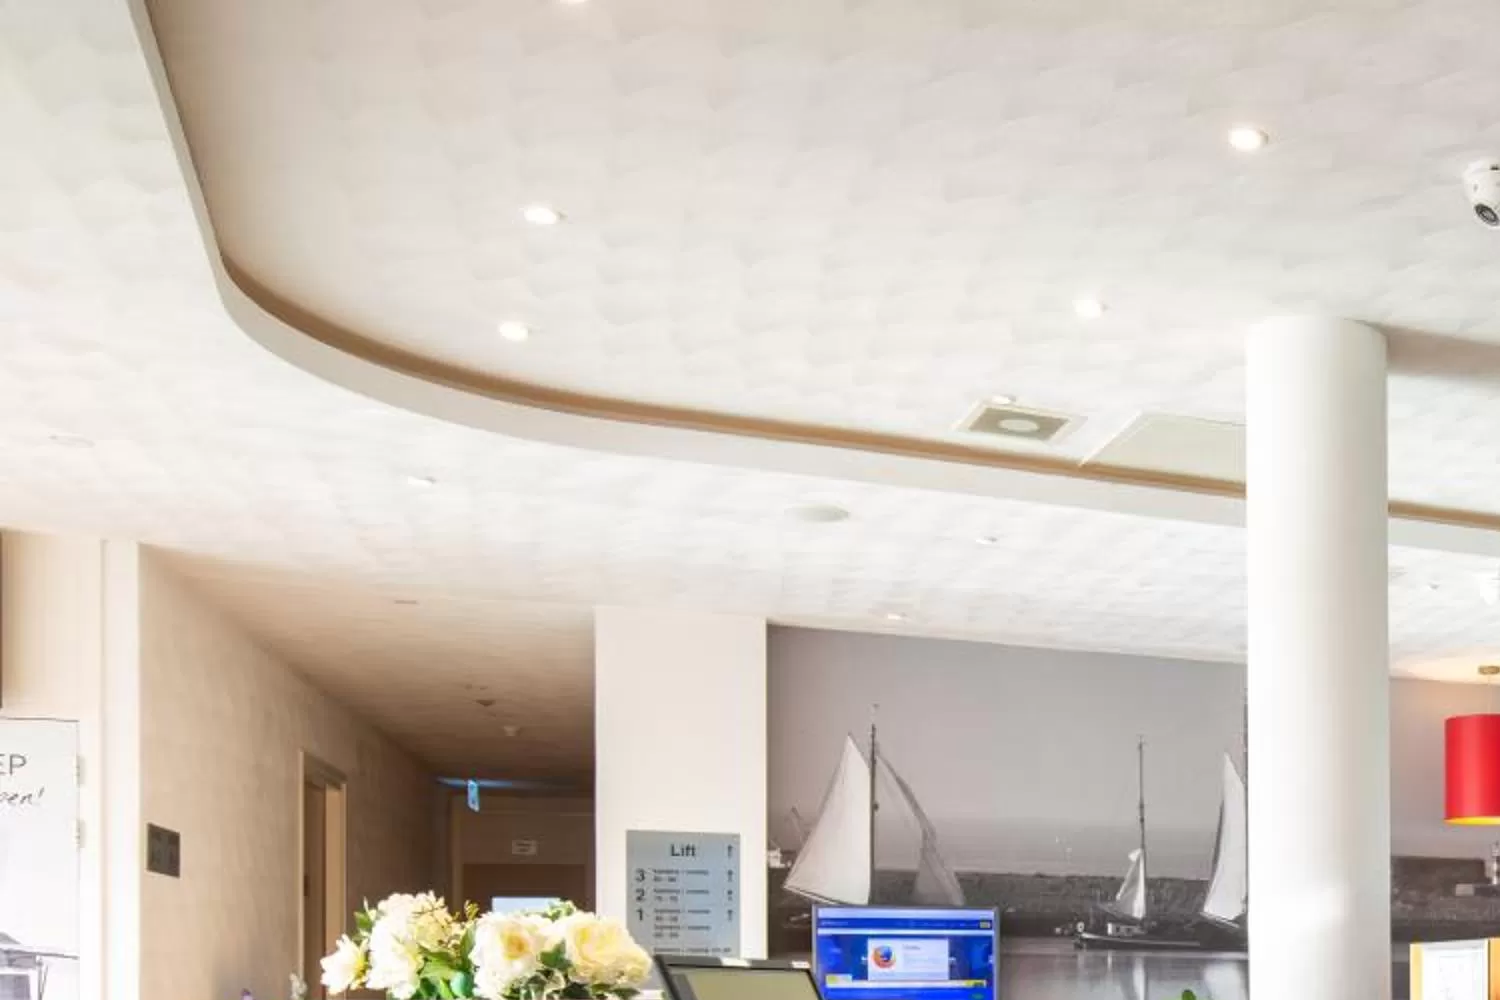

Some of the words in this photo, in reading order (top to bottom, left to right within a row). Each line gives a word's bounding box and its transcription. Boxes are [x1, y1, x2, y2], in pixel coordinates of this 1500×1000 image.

[670, 843, 697, 857] Lift
[635, 868, 645, 883] 3
[635, 888, 646, 902] 2
[636, 908, 644, 921] 1
